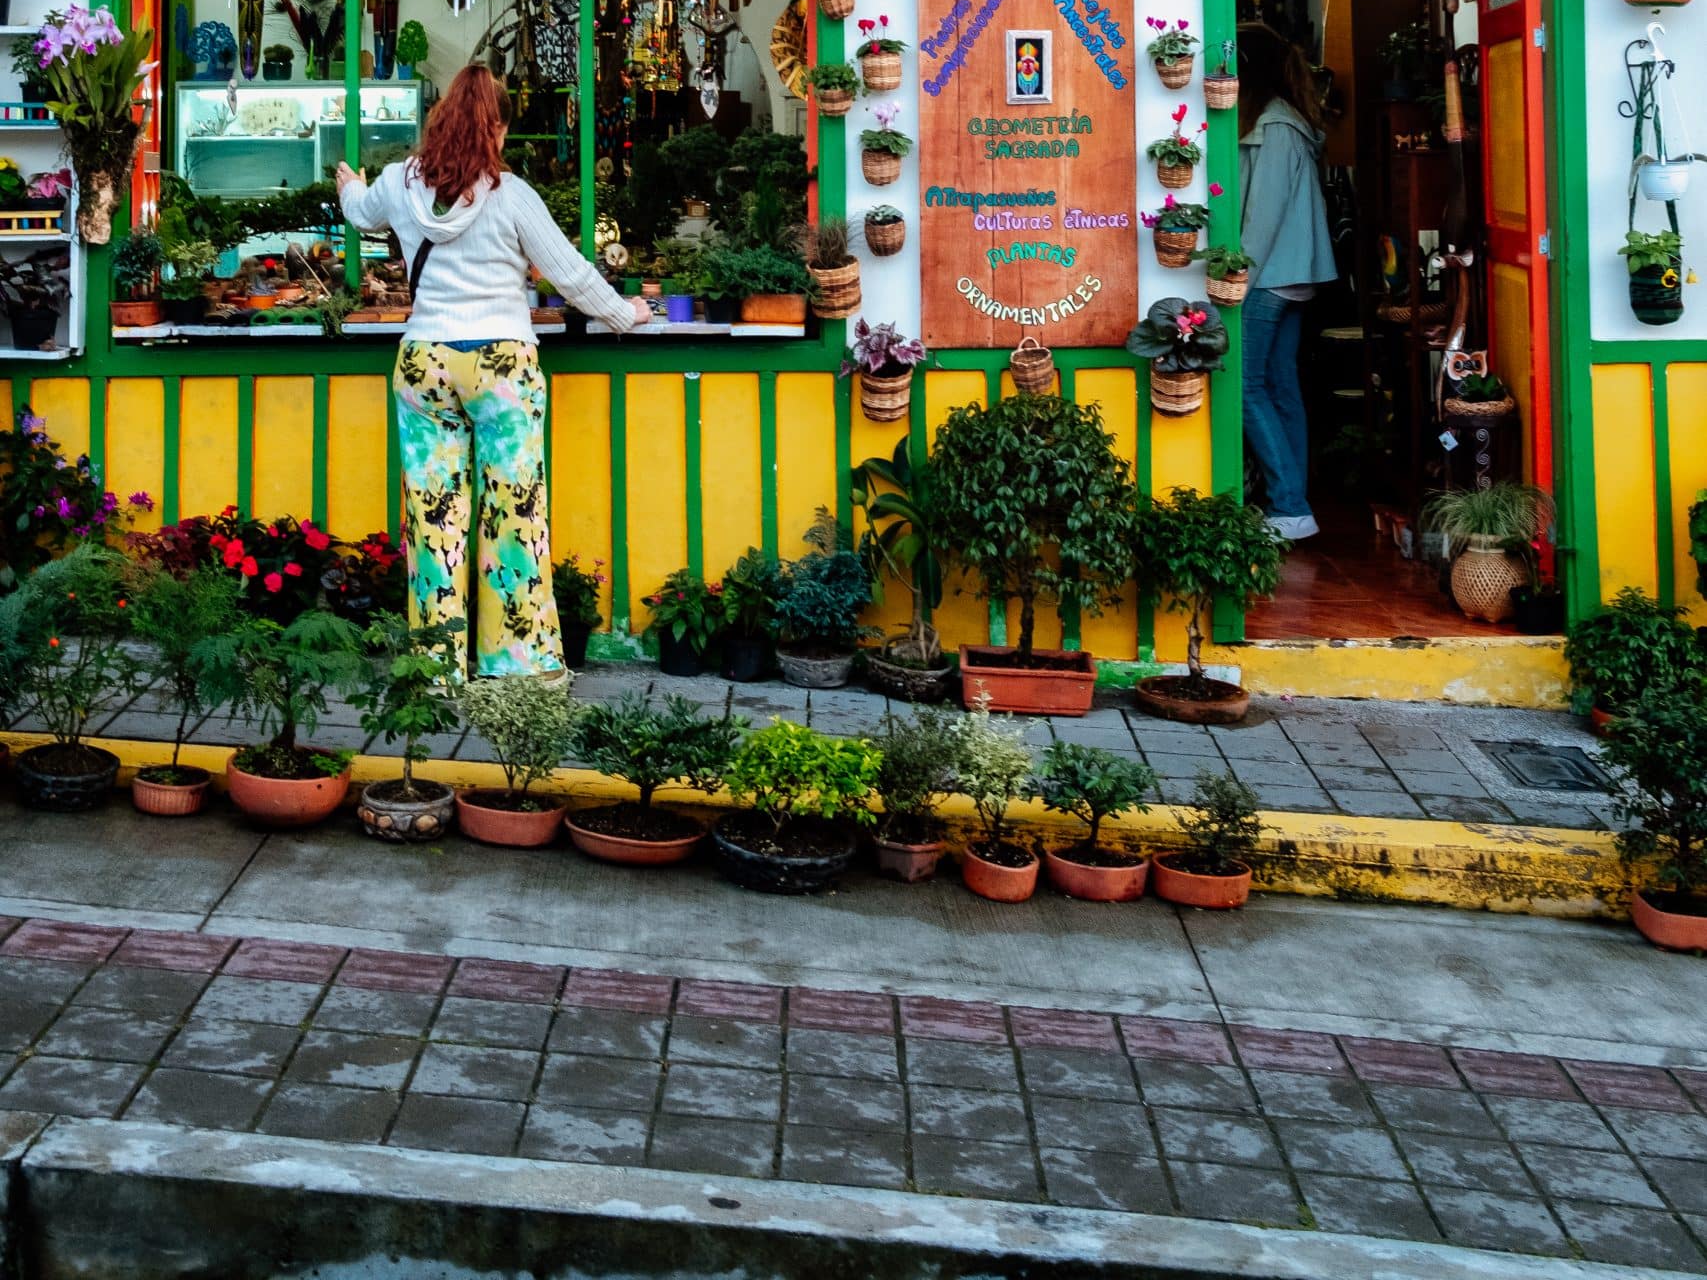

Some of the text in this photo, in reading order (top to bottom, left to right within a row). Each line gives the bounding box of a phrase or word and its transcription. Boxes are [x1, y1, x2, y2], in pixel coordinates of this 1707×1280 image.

[967, 108, 1093, 136] GEOMETRÍA
[985, 138, 1080, 160] SAGRADA
[956, 274, 1101, 326] ORNAMENTALES
